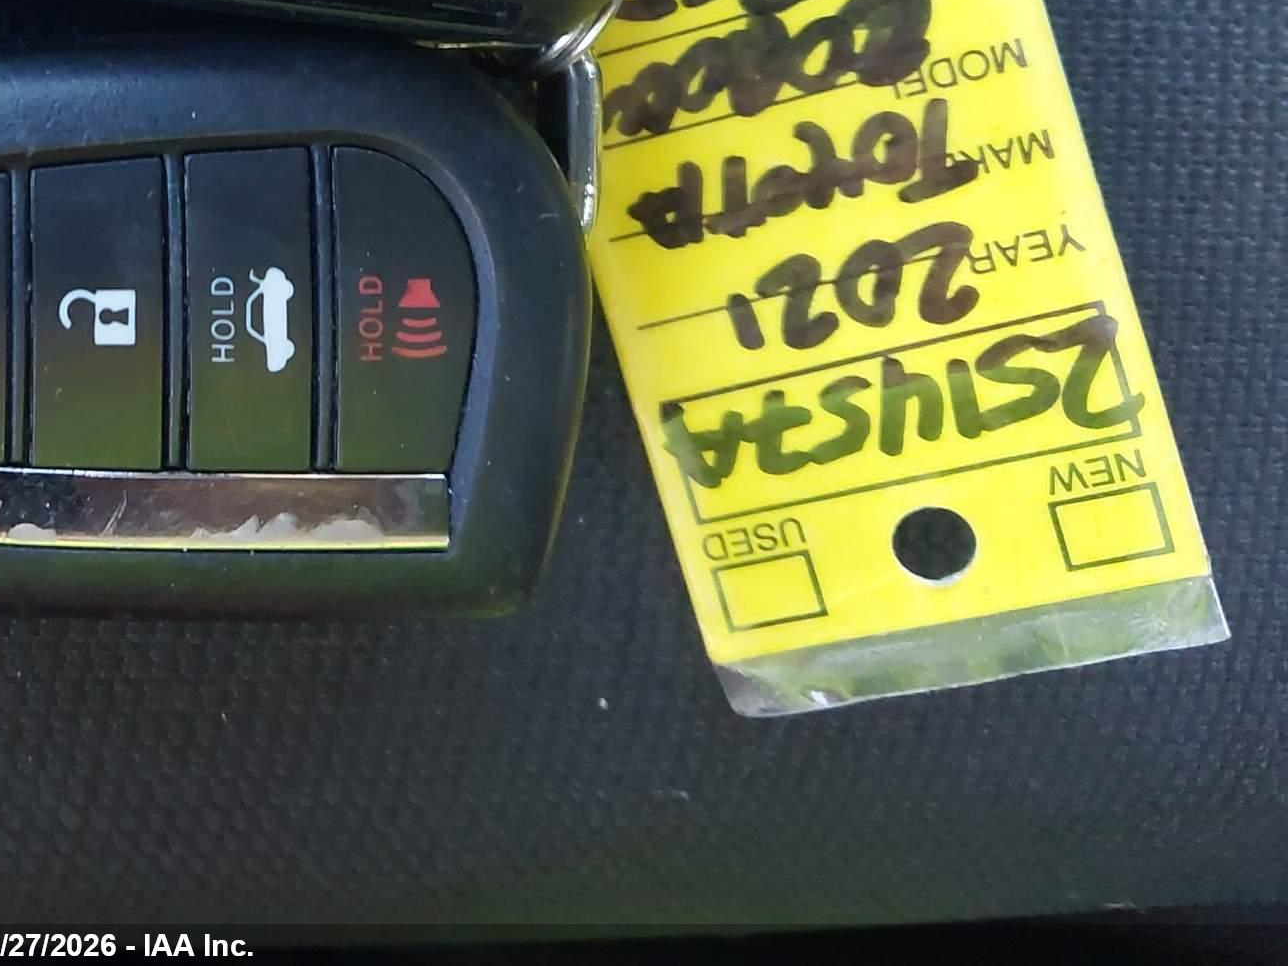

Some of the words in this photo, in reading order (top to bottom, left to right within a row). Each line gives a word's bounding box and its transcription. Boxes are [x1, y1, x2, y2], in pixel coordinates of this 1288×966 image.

[946, 129, 1056, 176] MAK
[969, 224, 1087, 275] YEAR
[727, 221, 981, 350] 2021
[210, 276, 236, 363] HOLD
[359, 275, 384, 362] HOLD
[1048, 448, 1148, 496] NEW
[702, 517, 807, 562] USED
